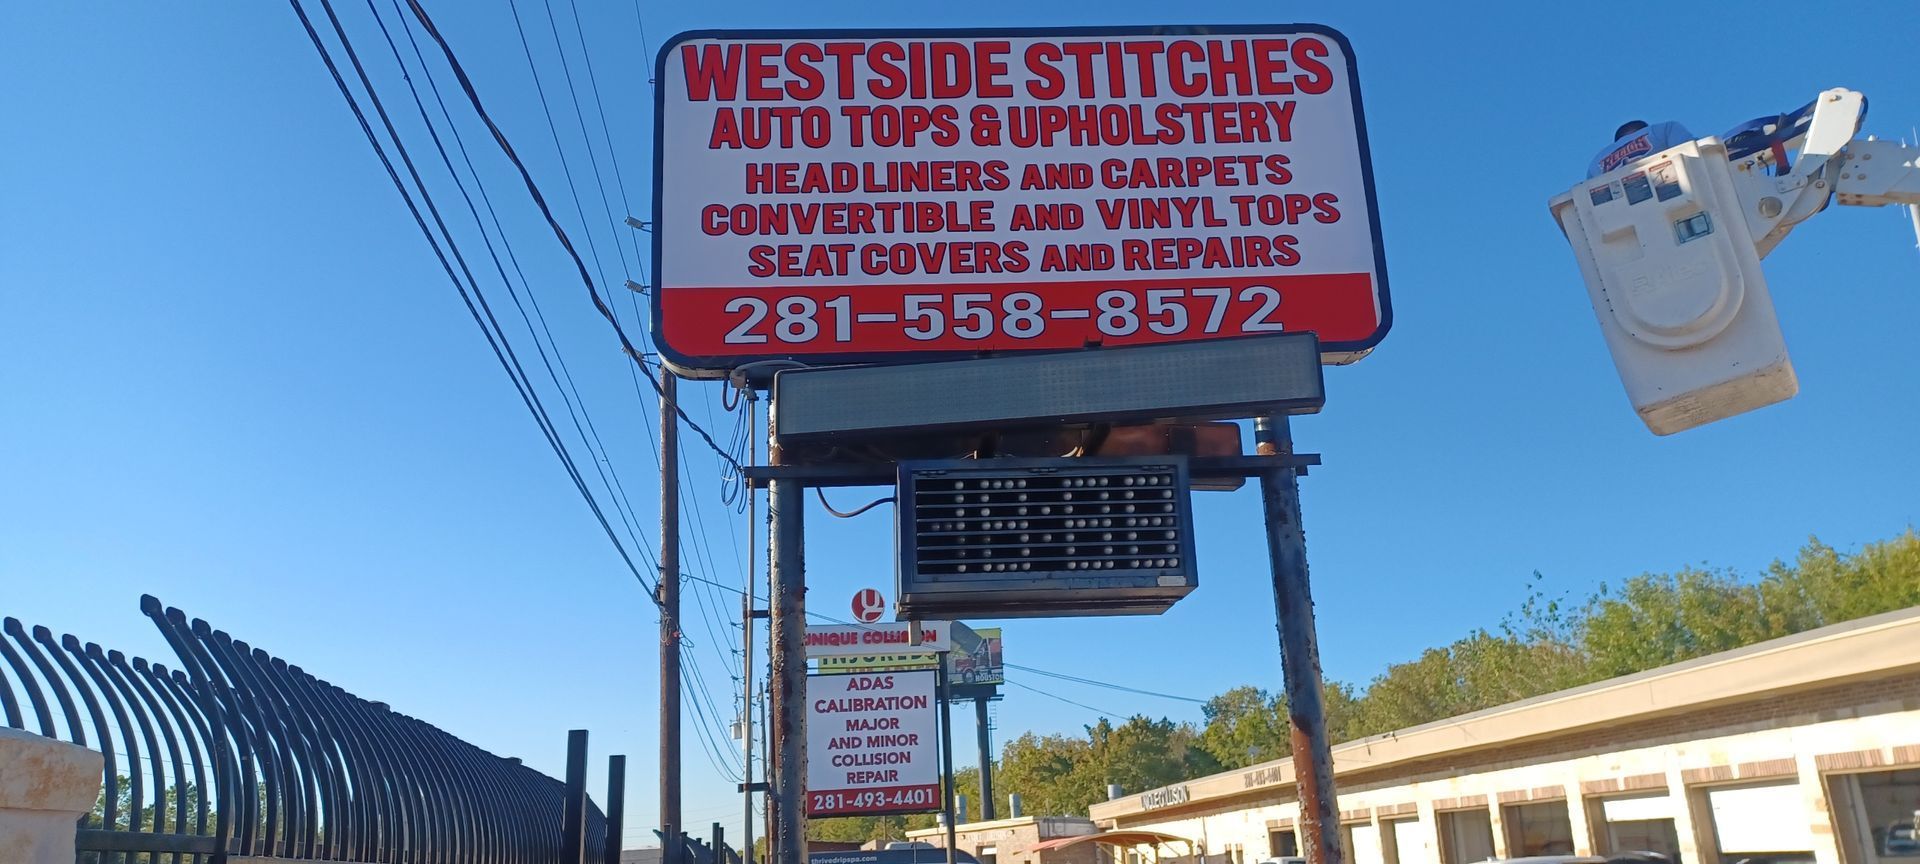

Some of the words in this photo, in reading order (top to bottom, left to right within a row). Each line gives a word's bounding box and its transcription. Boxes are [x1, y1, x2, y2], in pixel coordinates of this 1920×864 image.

[681, 41, 1013, 101] WESTSIDE
[1024, 37, 1334, 99] STITCHES
[709, 106, 831, 149] AUTO
[841, 105, 960, 147] TOPS
[970, 105, 1002, 146] &
[1008, 101, 1296, 147] UPHOLSTERY
[1020, 163, 1094, 190] AND
[1100, 154, 1293, 190] CARPETS
[701, 201, 995, 236] CONVERTIBLE
[1010, 203, 1084, 231] AND
[1095, 196, 1228, 229] VINYL
[1230, 193, 1341, 226] TOPS
[748, 244, 855, 277] SEAT
[861, 241, 1030, 275] COVERS
[1040, 243, 1115, 272] AND
[1122, 234, 1301, 270] REPAIRS
[724, 285, 1284, 344] 281-558-8572
[846, 676, 894, 691] ADAS
[814, 695, 927, 713] CALIBRATION
[846, 717, 900, 731] MAJOR
[827, 737, 862, 750] AND
[866, 734, 918, 748] MINOR
[832, 751, 911, 767] COLLISION
[846, 770, 898, 784] REPAIR
[814, 788, 933, 810] 281-493-4401
